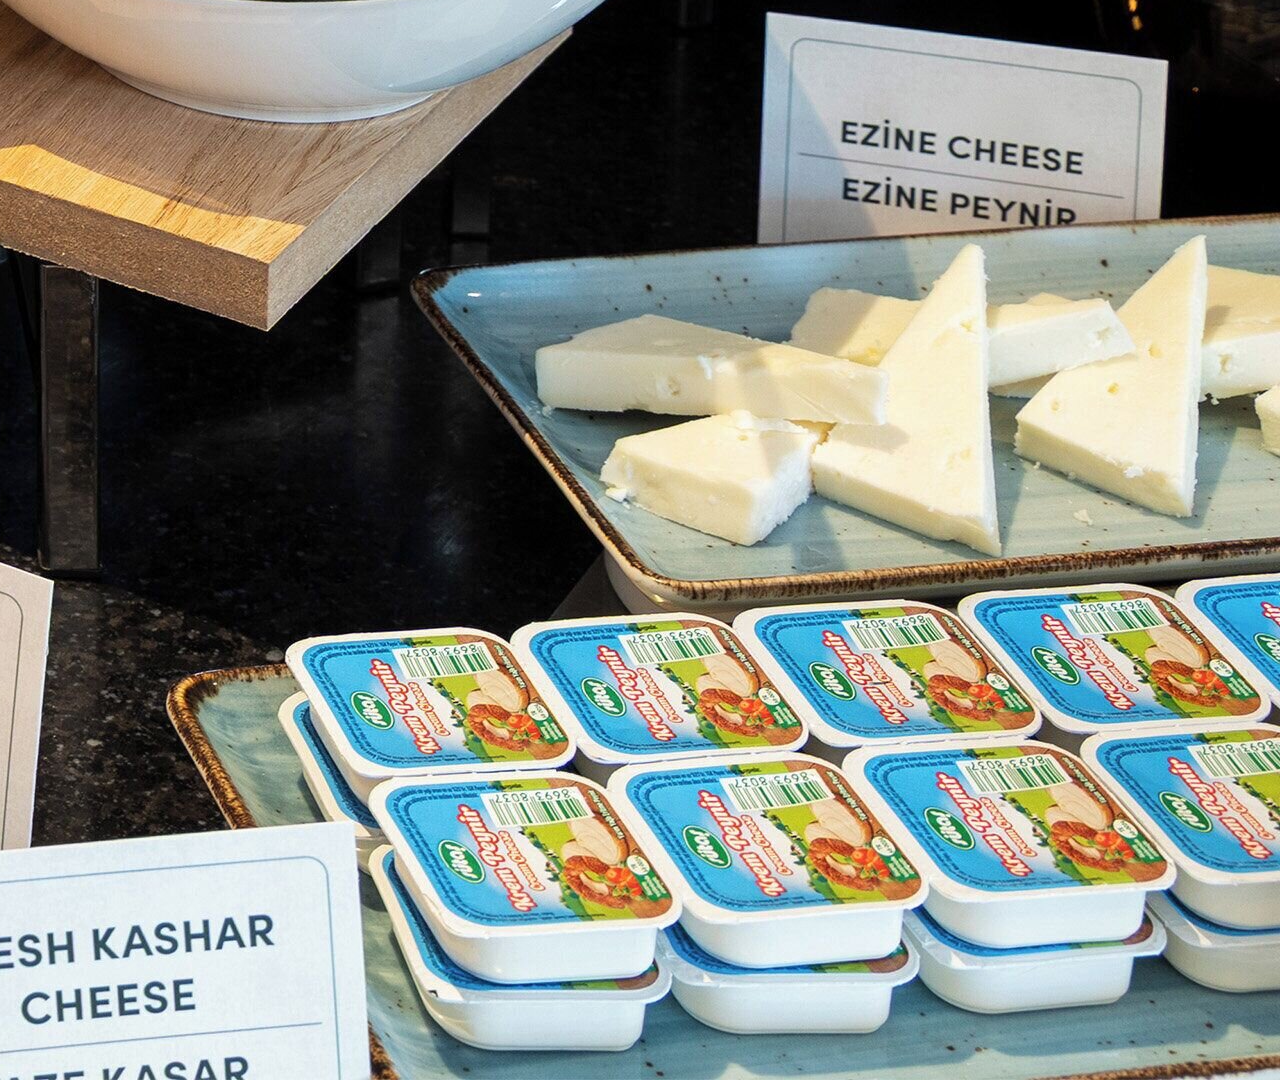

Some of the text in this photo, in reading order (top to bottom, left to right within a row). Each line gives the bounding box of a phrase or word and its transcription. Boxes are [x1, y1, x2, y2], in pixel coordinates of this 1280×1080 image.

[841, 119, 1084, 175] EZİNE CHEESE
[842, 176, 1076, 226] EZİNE PEYNİR
[1073, 603, 1106, 614] 8037
[1110, 600, 1144, 610] 8693
[855, 619, 888, 629] 8037
[892, 615, 926, 626] 8693
[632, 632, 664, 644] 8037
[406, 647, 439, 658] 8037
[445, 644, 477, 654] 8693
[1042, 614, 1134, 710] Krem Peynir
[822, 630, 908, 725] Krem Peynir
[597, 644, 676, 741] Krem Peynir
[369, 658, 442, 755] Krem Peynir
[1201, 744, 1236, 756] 8037
[1239, 740, 1275, 751] 8693
[970, 759, 1005, 771] 8037
[1009, 755, 1045, 767] 8693
[734, 776, 769, 788] 8037
[774, 771, 809, 783] 8693
[1168, 756, 1227, 817] Peynir
[495, 792, 530, 804] 8037
[536, 789, 570, 800] 8693
[936, 772, 1032, 877] Krem Peynir
[698, 789, 786, 896] Krem Peynir
[1219, 816, 1271, 860] Krem
[456, 804, 537, 912] Krem Peynir
[92, 914, 275, 961] KASHAR
[20, 978, 197, 1025] CHEESE
